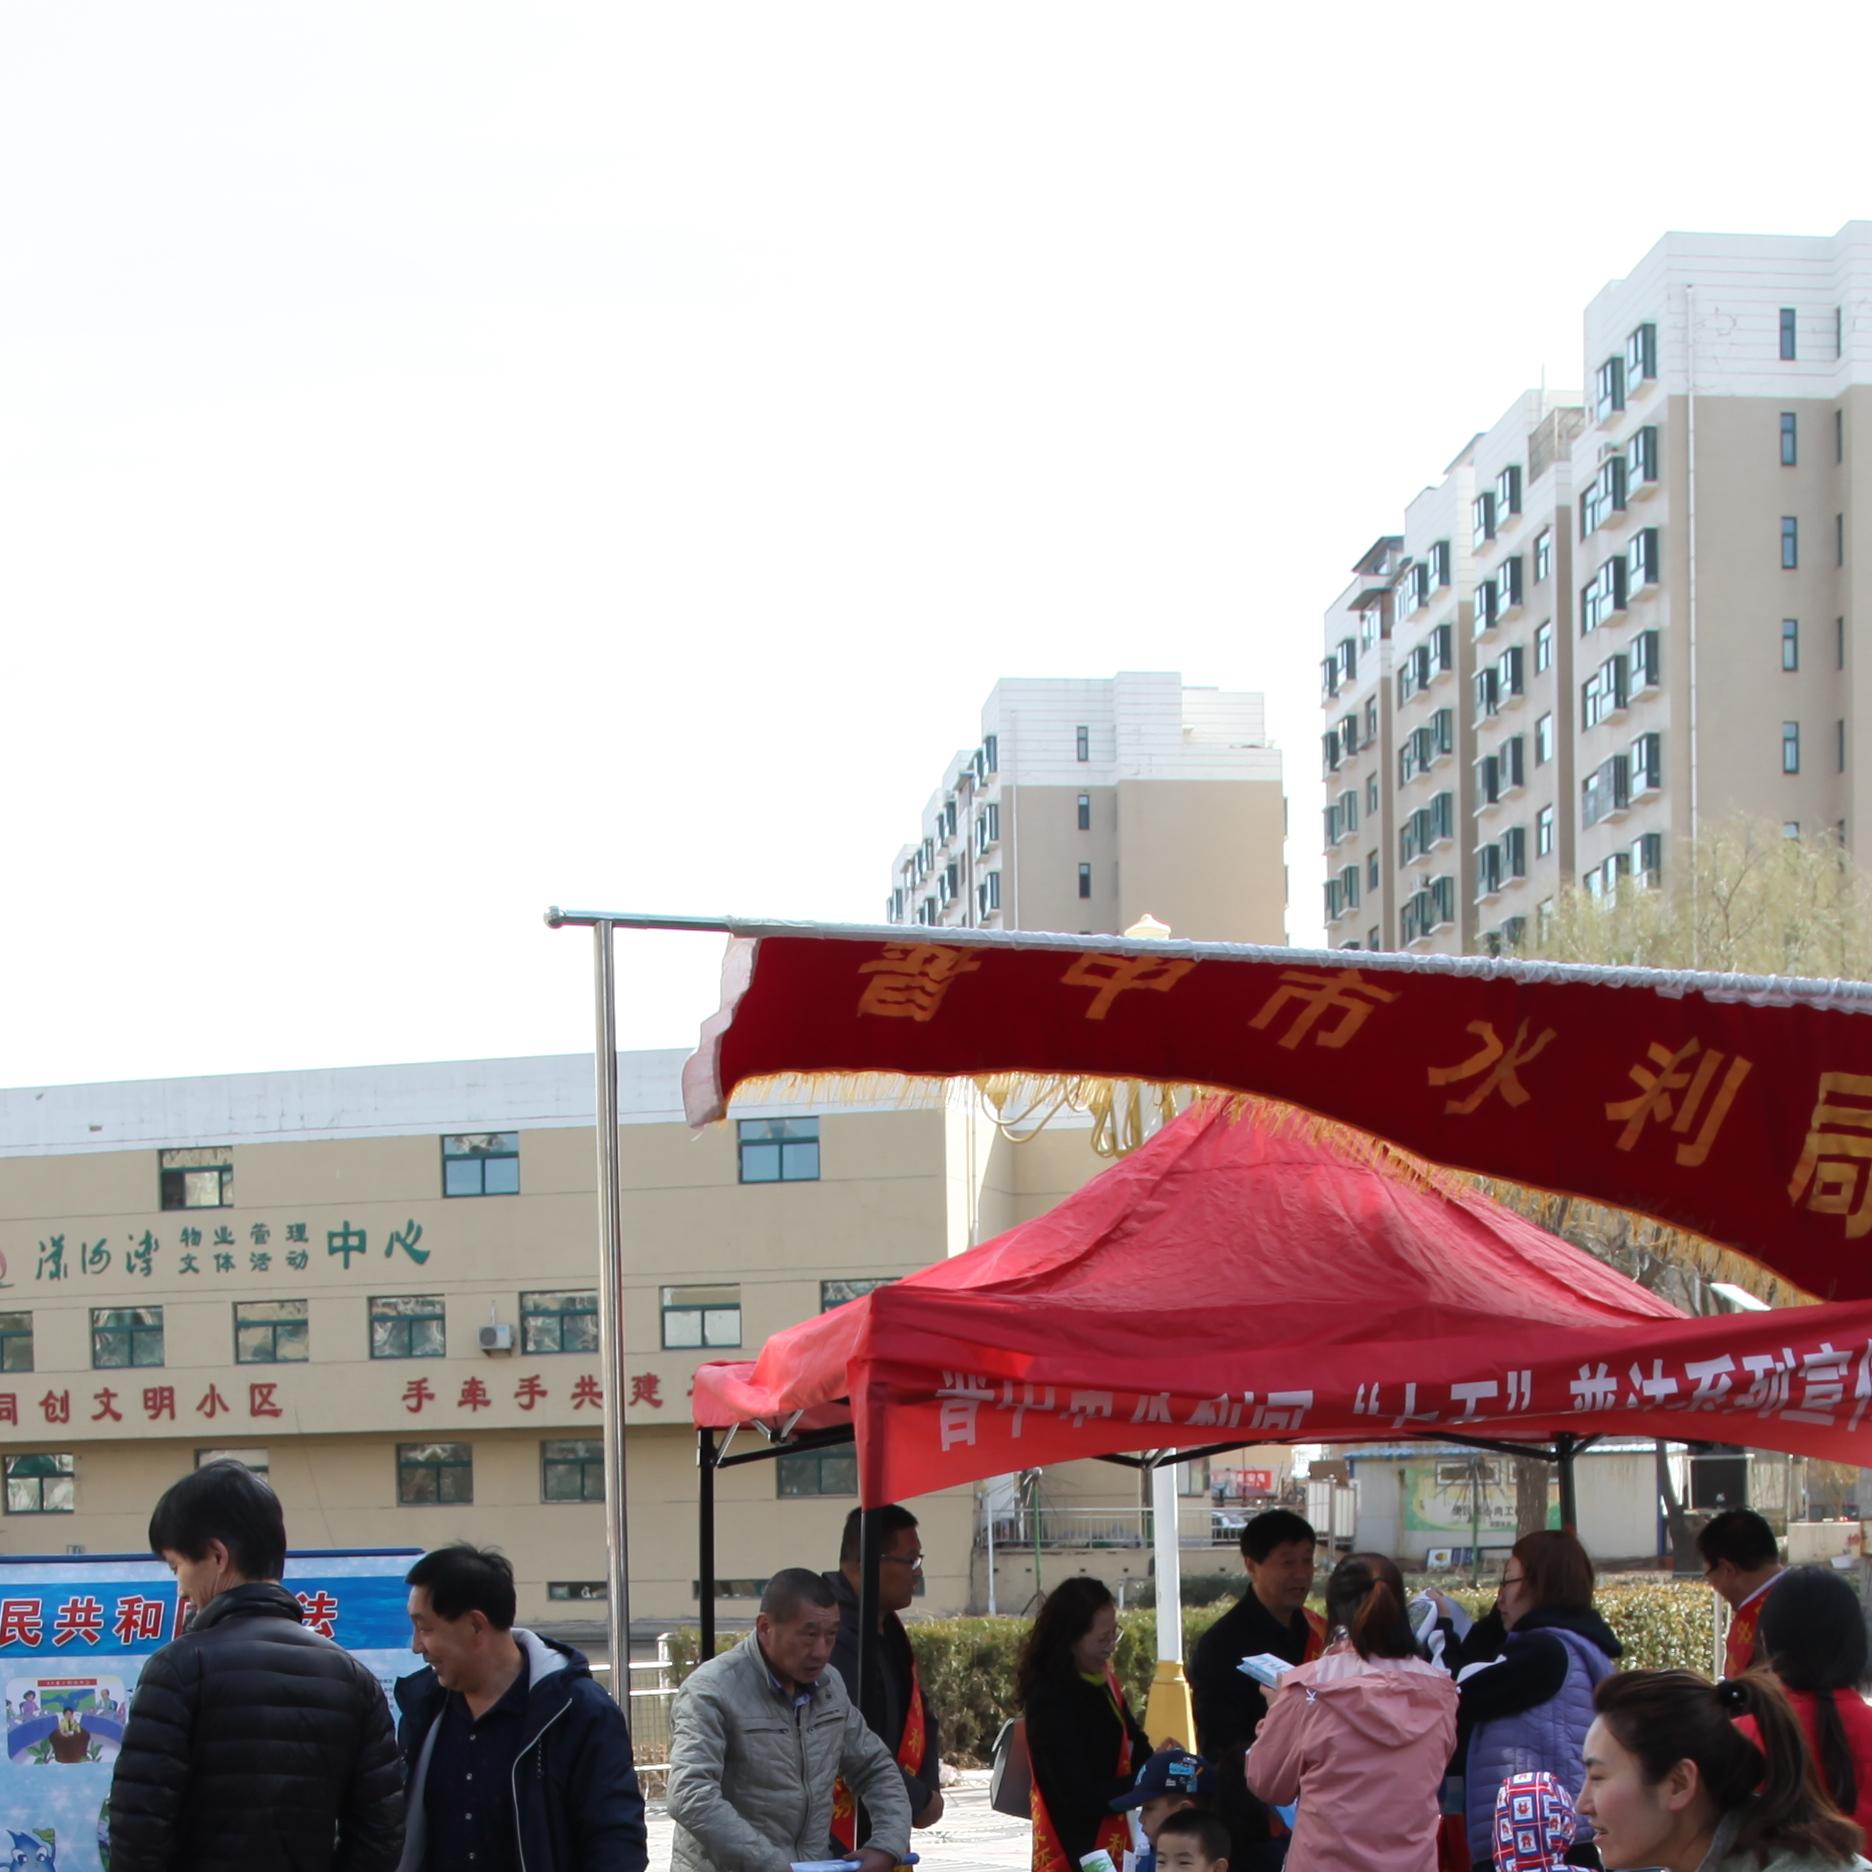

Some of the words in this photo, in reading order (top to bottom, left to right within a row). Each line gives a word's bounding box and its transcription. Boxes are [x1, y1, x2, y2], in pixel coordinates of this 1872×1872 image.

[178, 1250, 309, 1275] 文体活动
[180, 1222, 309, 1247] 物业管理
[327, 1218, 432, 1269] 中心
[401, 1371, 695, 1413] 手牵手共建
